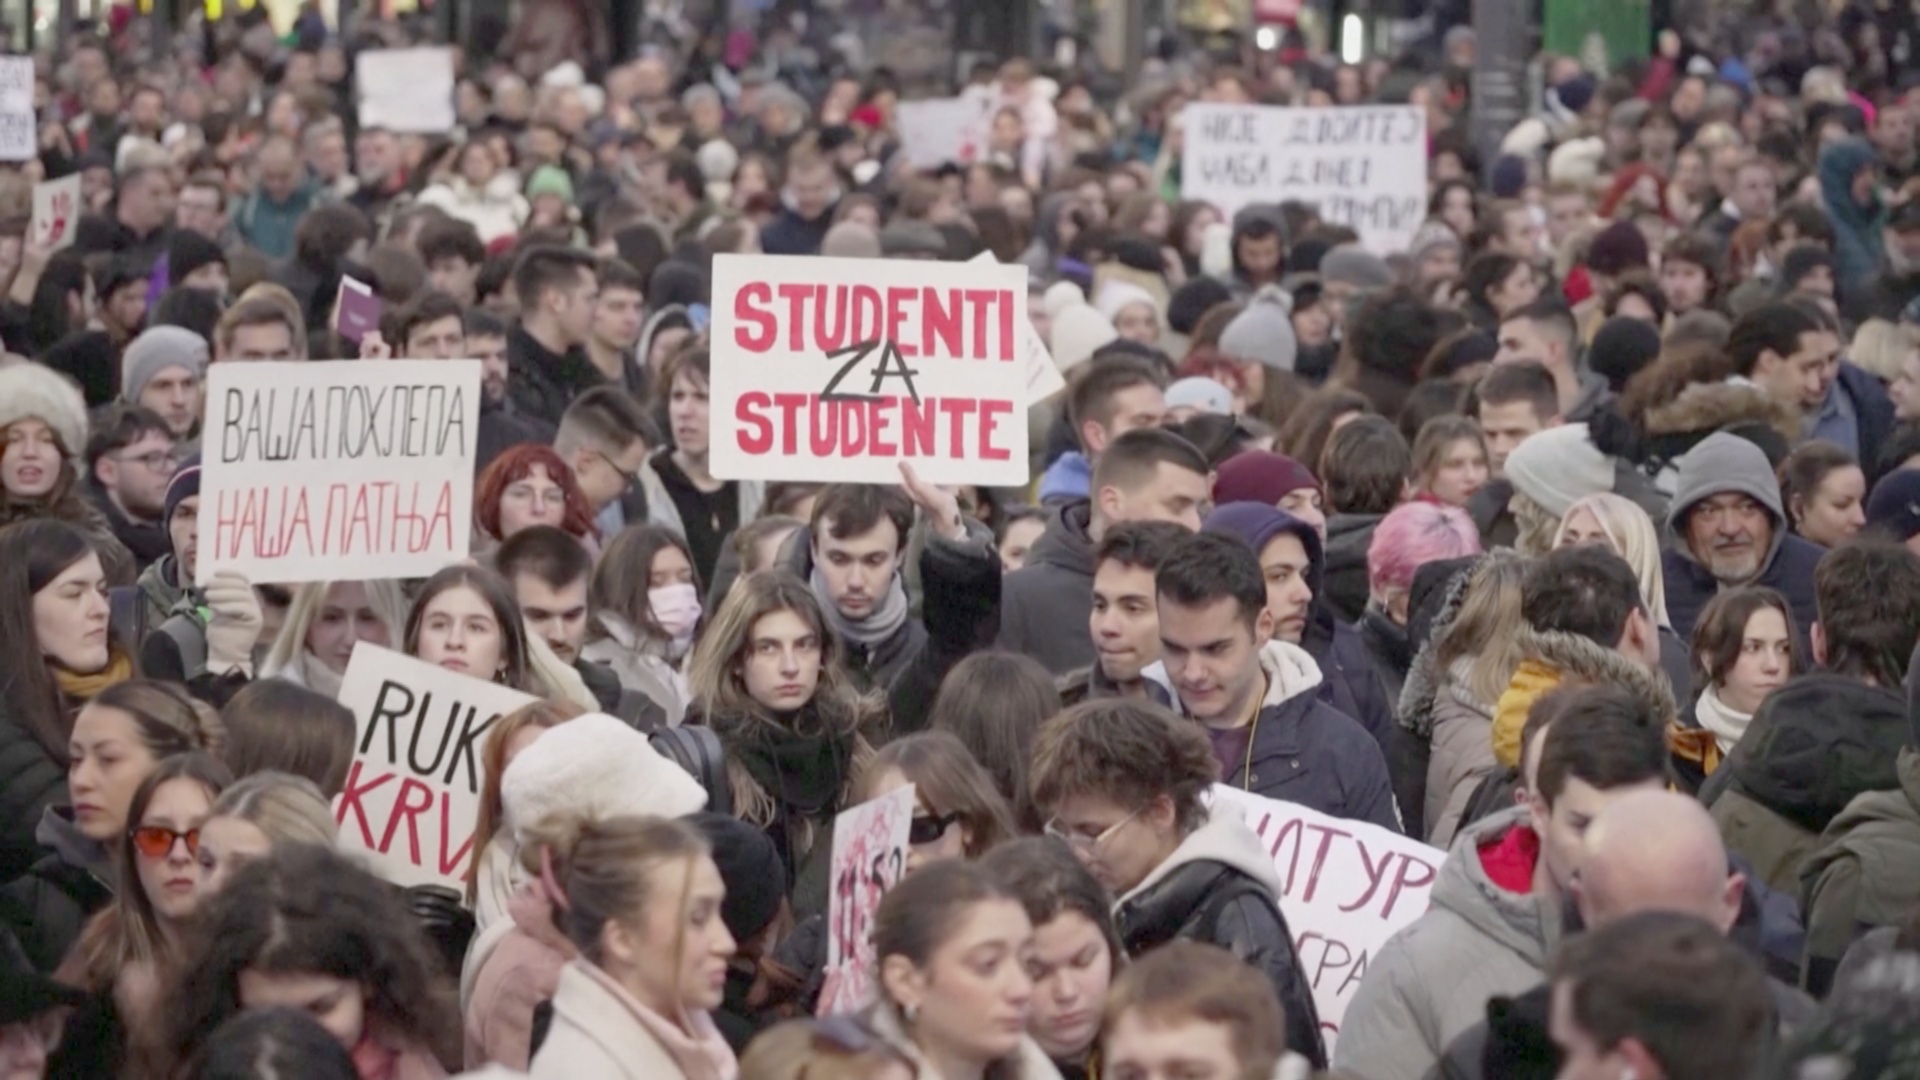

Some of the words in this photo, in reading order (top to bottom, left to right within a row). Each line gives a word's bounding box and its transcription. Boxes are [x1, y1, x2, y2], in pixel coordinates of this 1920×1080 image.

[734, 281, 1014, 362] STUDENTI
[819, 338, 921, 406] ZA
[221, 386, 317, 464] ВАША
[321, 384, 465, 459] ПОХЛЕПА
[735, 391, 1013, 461] STUDENTE
[215, 485, 315, 560] НАША
[321, 480, 453, 557] ПАТЊА
[336, 760, 477, 883] KRV
